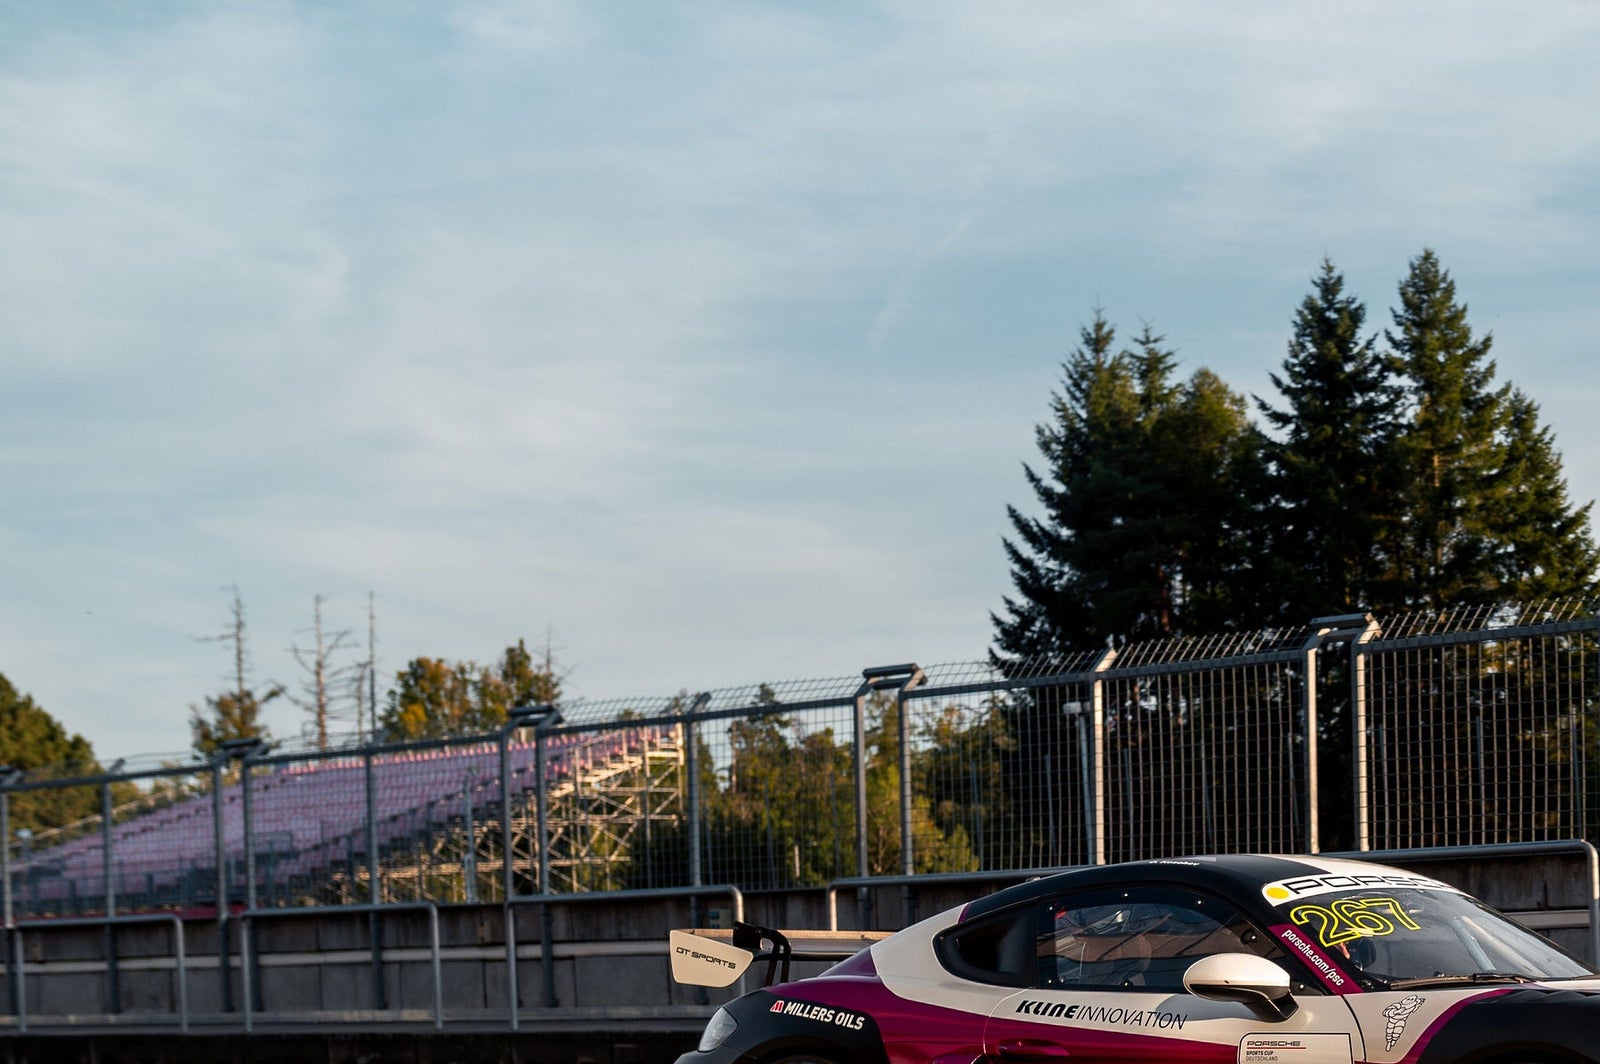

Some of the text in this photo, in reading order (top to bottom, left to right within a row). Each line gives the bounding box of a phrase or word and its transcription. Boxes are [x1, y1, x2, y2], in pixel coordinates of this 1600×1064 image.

[1290, 898, 1421, 947] 267
[676, 946, 737, 970] GT SPORTS
[1281, 929, 1345, 987] porsche.com/psc
[783, 1001, 865, 1030] MILLERS OILS
